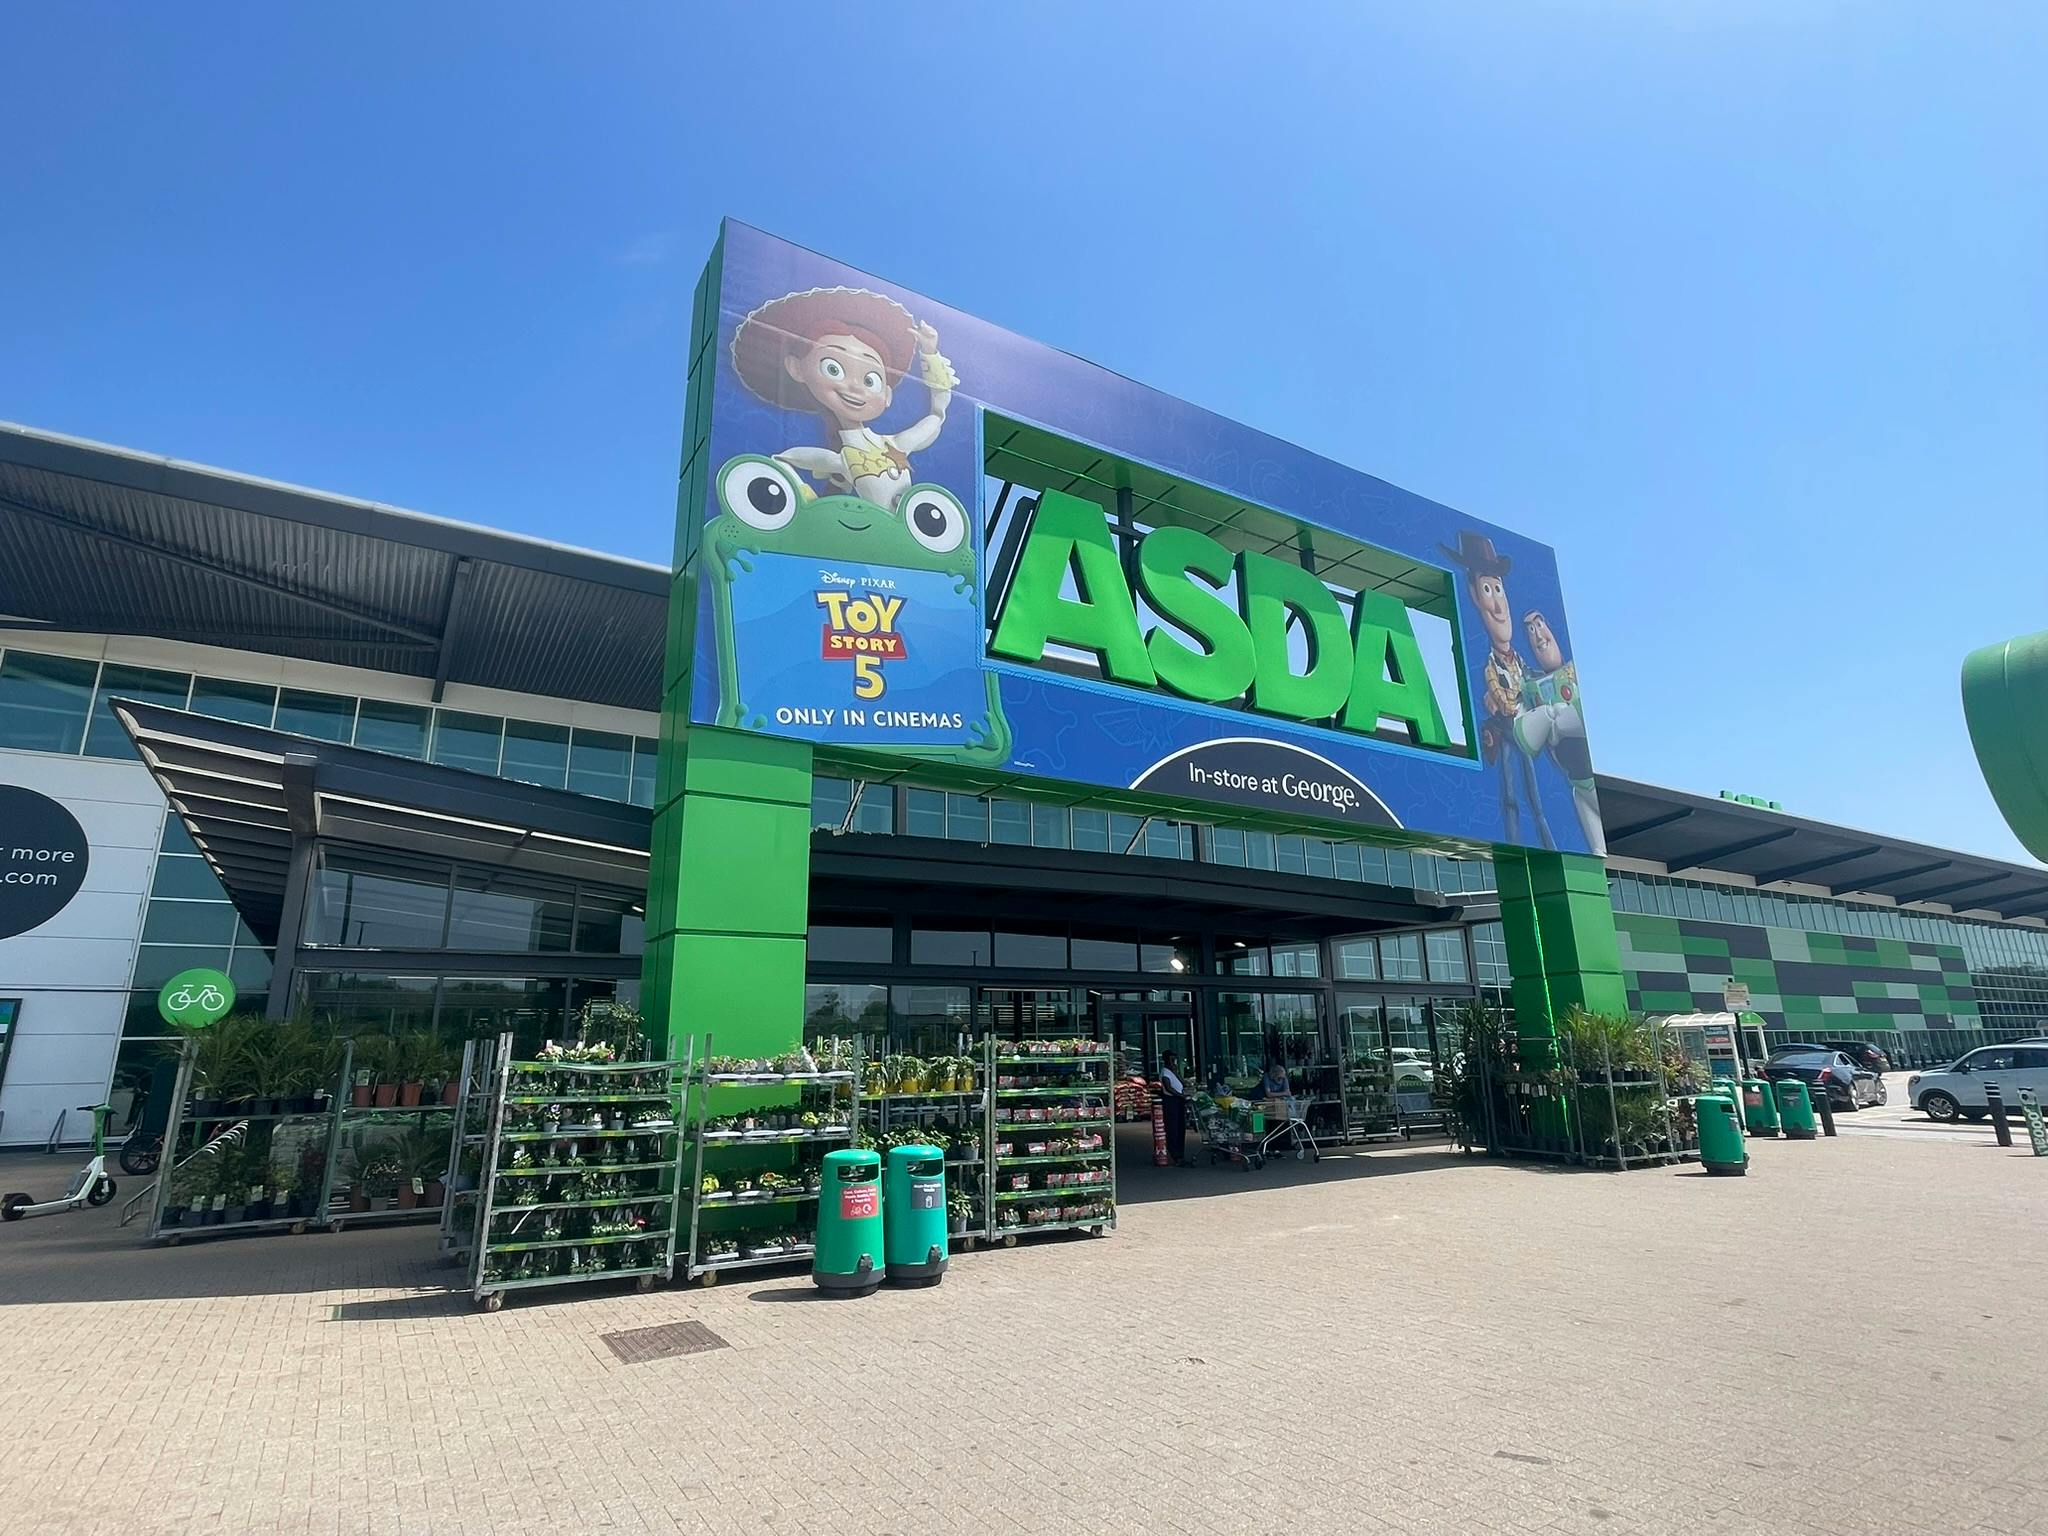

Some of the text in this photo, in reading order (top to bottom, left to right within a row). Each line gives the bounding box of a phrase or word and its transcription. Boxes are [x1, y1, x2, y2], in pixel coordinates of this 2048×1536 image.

[818, 570, 896, 589] Disney PIXAR
[816, 590, 905, 633] TOY
[991, 487, 1452, 748] ASDA
[830, 635, 897, 653] STORY
[855, 656, 883, 698] 5
[776, 707, 963, 729] ONLY IN CINEMAS
[1189, 762, 1360, 814] In-store at George.
[11, 848, 75, 863] more
